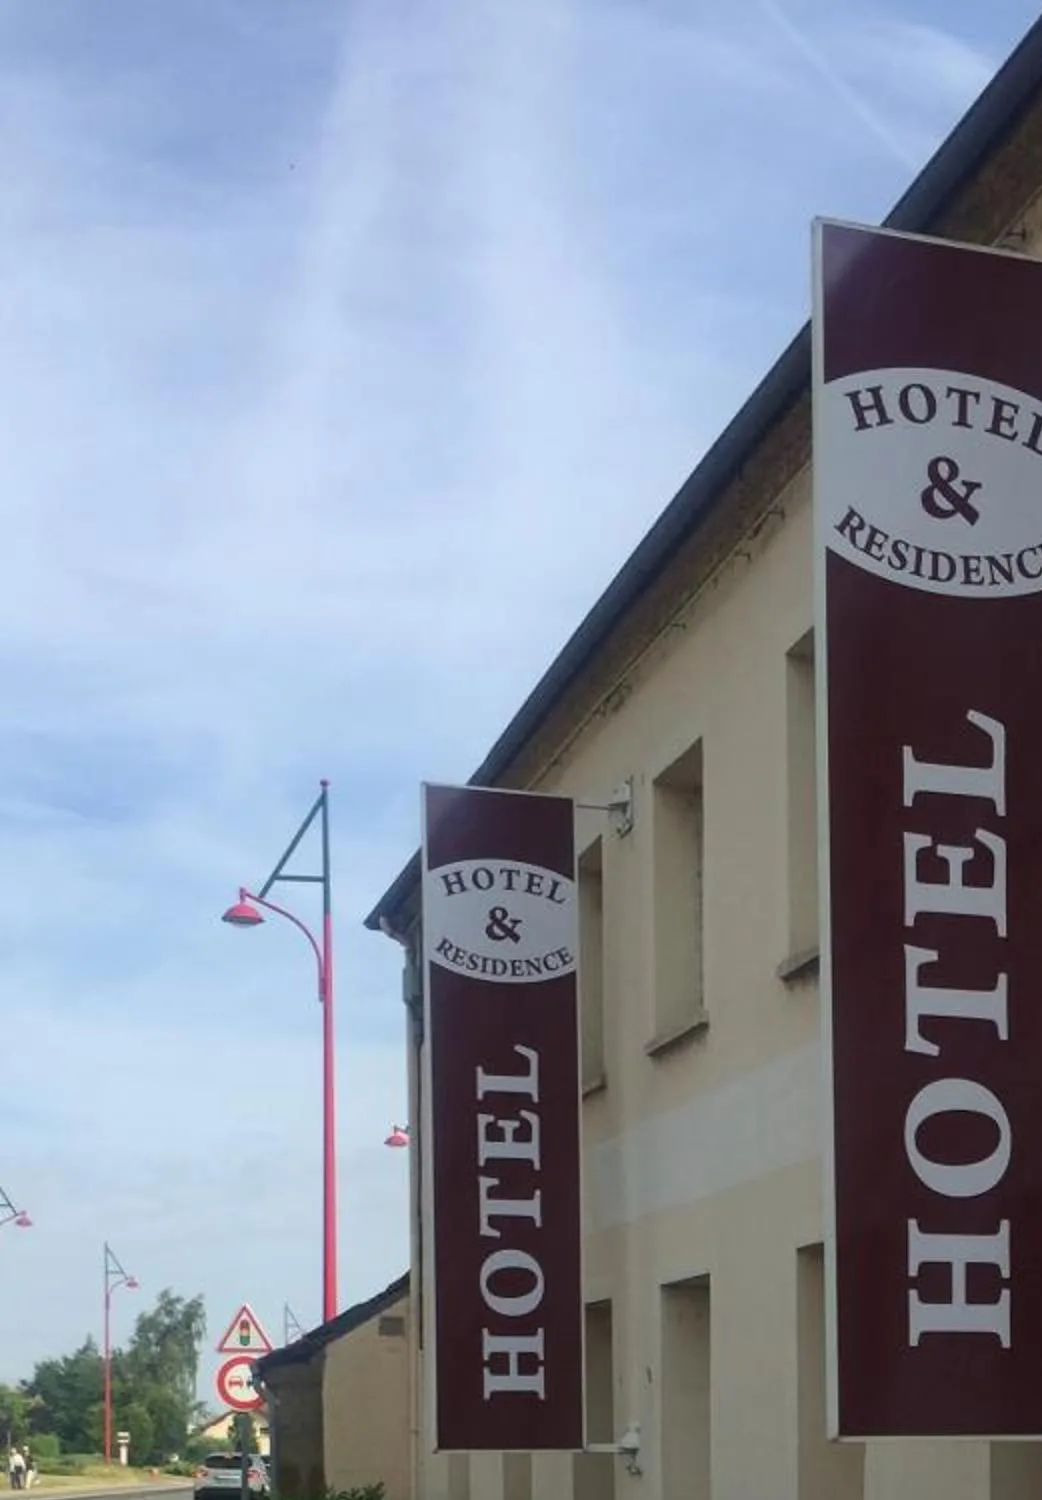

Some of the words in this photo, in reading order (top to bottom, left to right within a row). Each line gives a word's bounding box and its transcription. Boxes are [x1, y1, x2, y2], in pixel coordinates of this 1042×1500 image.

[920, 455, 982, 527] &
[440, 866, 567, 905] HOTEL
[485, 906, 523, 944] &
[435, 937, 574, 978] RESIDENCE
[903, 709, 1011, 1349] HOTEL
[476, 1044, 545, 1400] HOTEL
